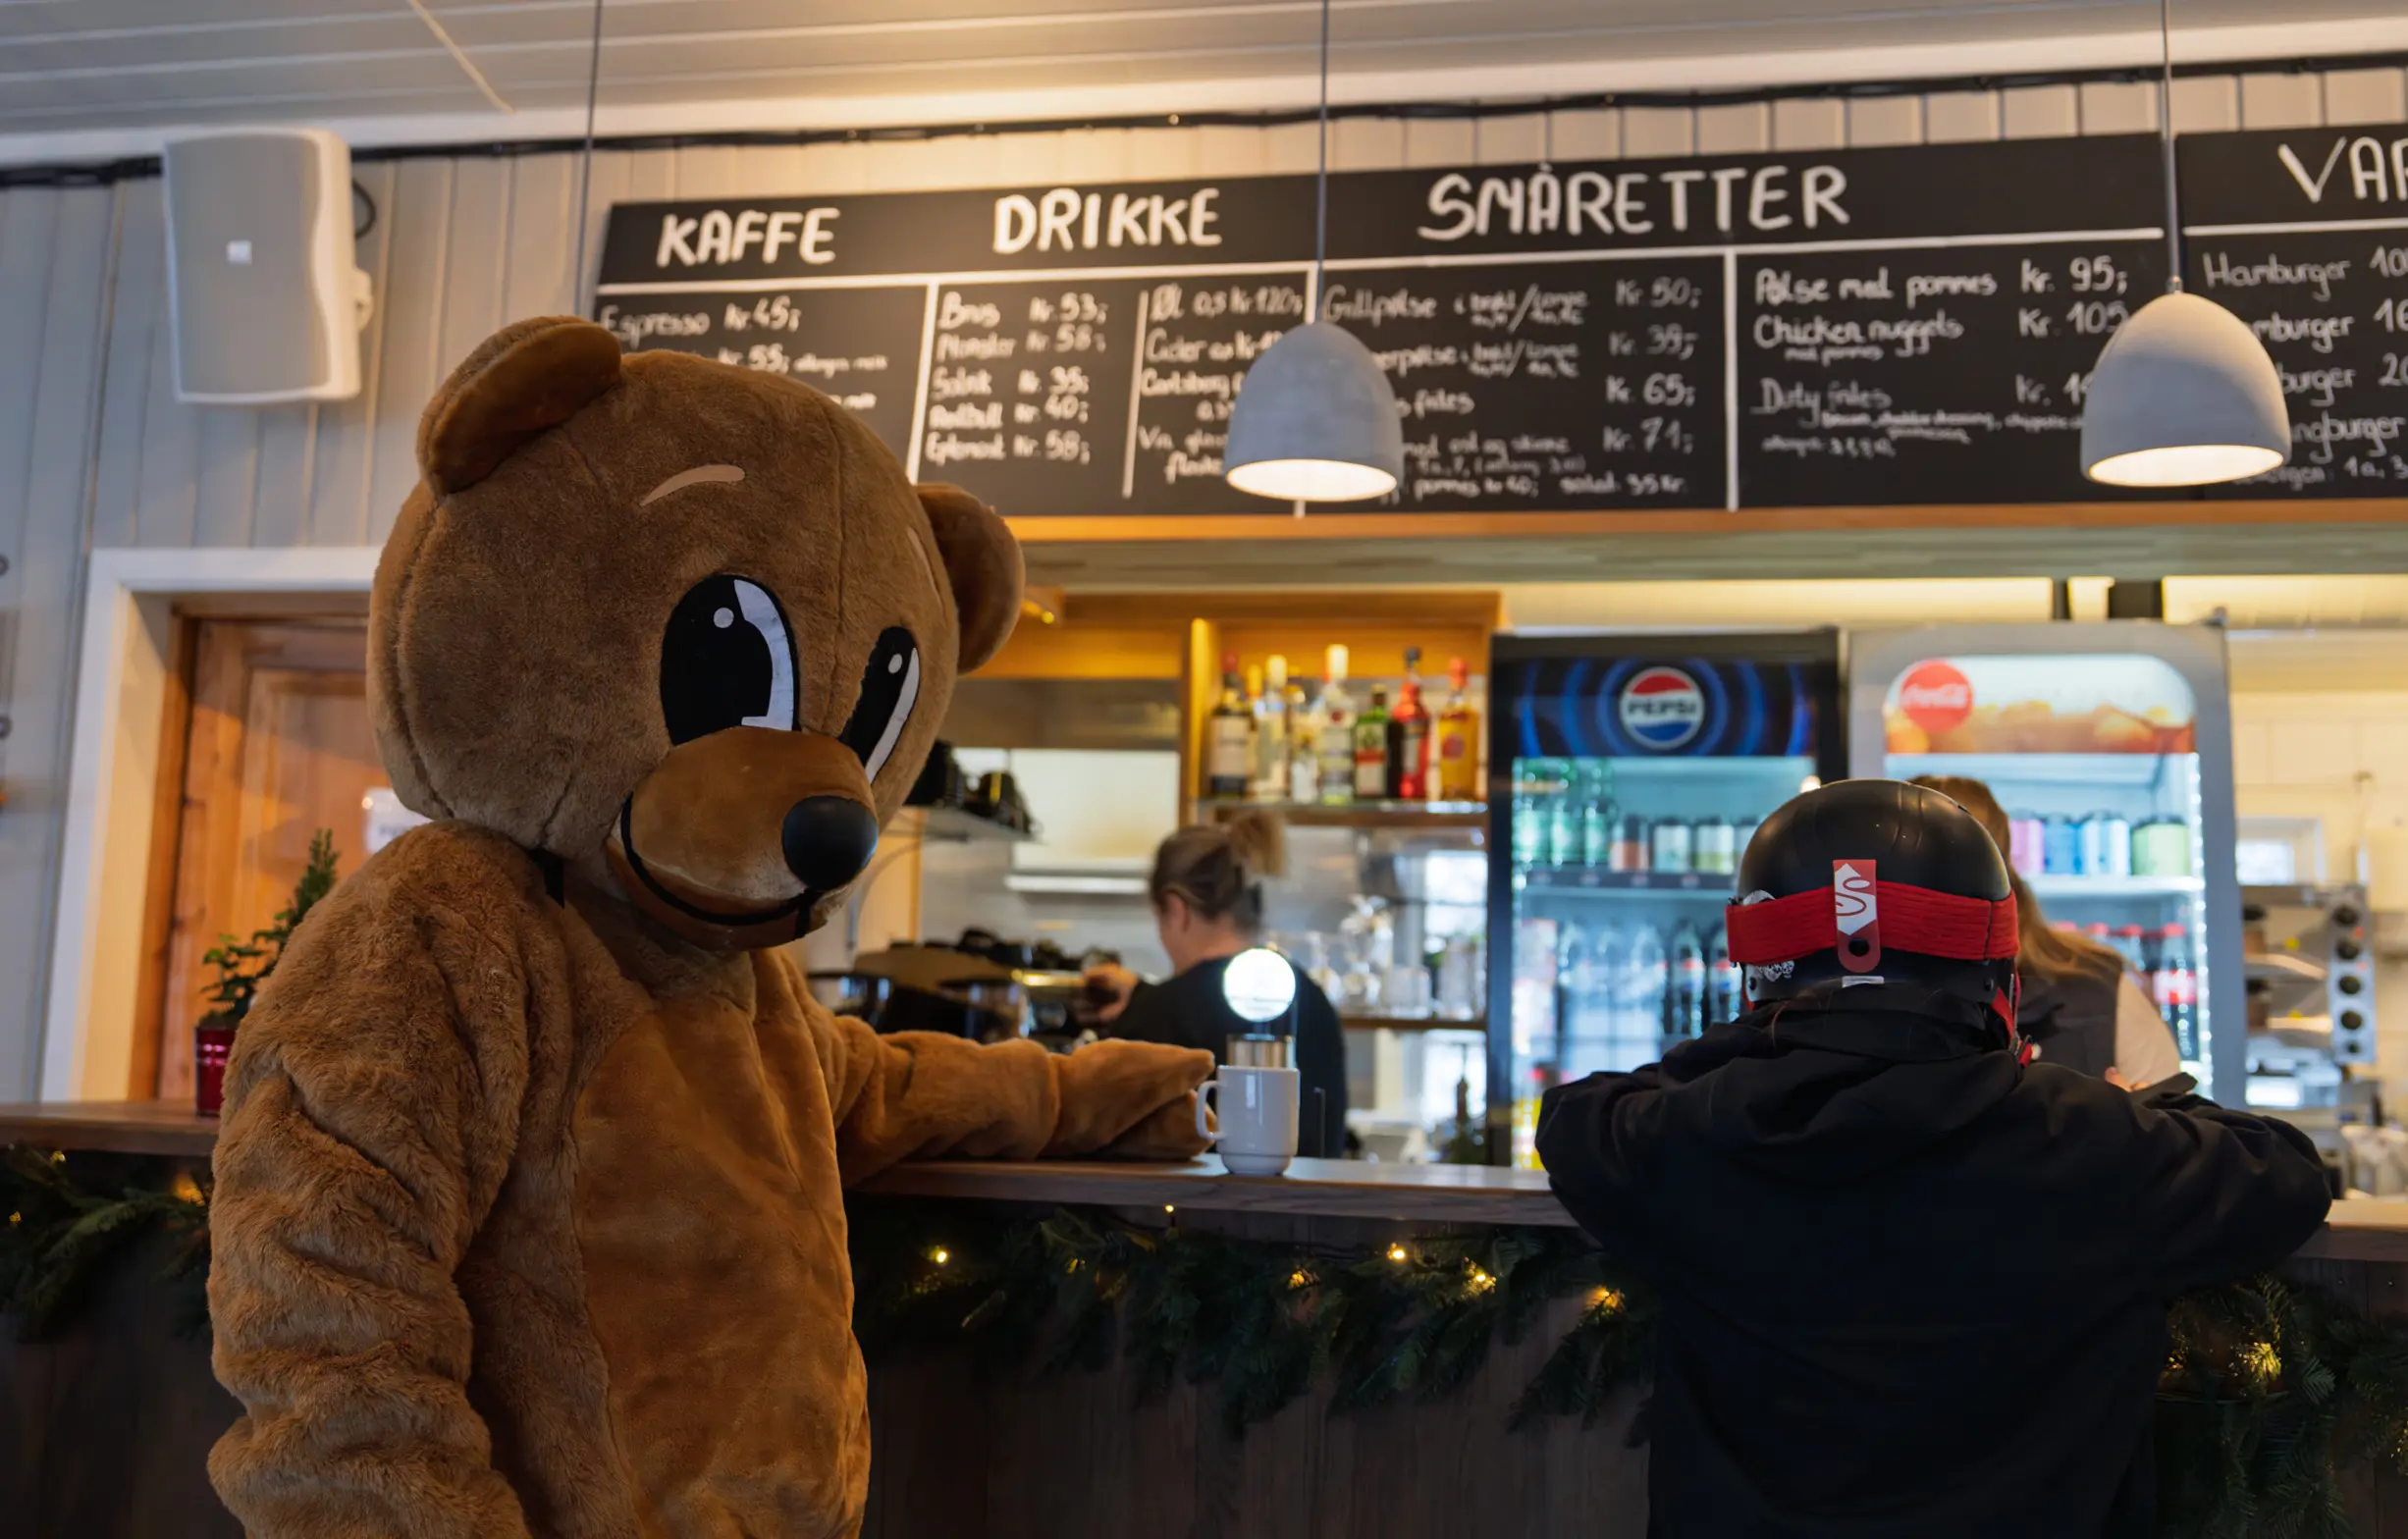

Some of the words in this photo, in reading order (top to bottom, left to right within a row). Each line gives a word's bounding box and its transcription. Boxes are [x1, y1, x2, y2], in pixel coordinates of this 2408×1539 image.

[993, 187, 1222, 254] DRIKKE
[1418, 162, 1850, 240] SMÅRETTER
[656, 206, 841, 268] KAFFE
[2203, 251, 2351, 301] Hamburger
[600, 304, 711, 349] Espresso
[1753, 314, 1865, 348] Chicken
[1868, 308, 1963, 358] nuggets
